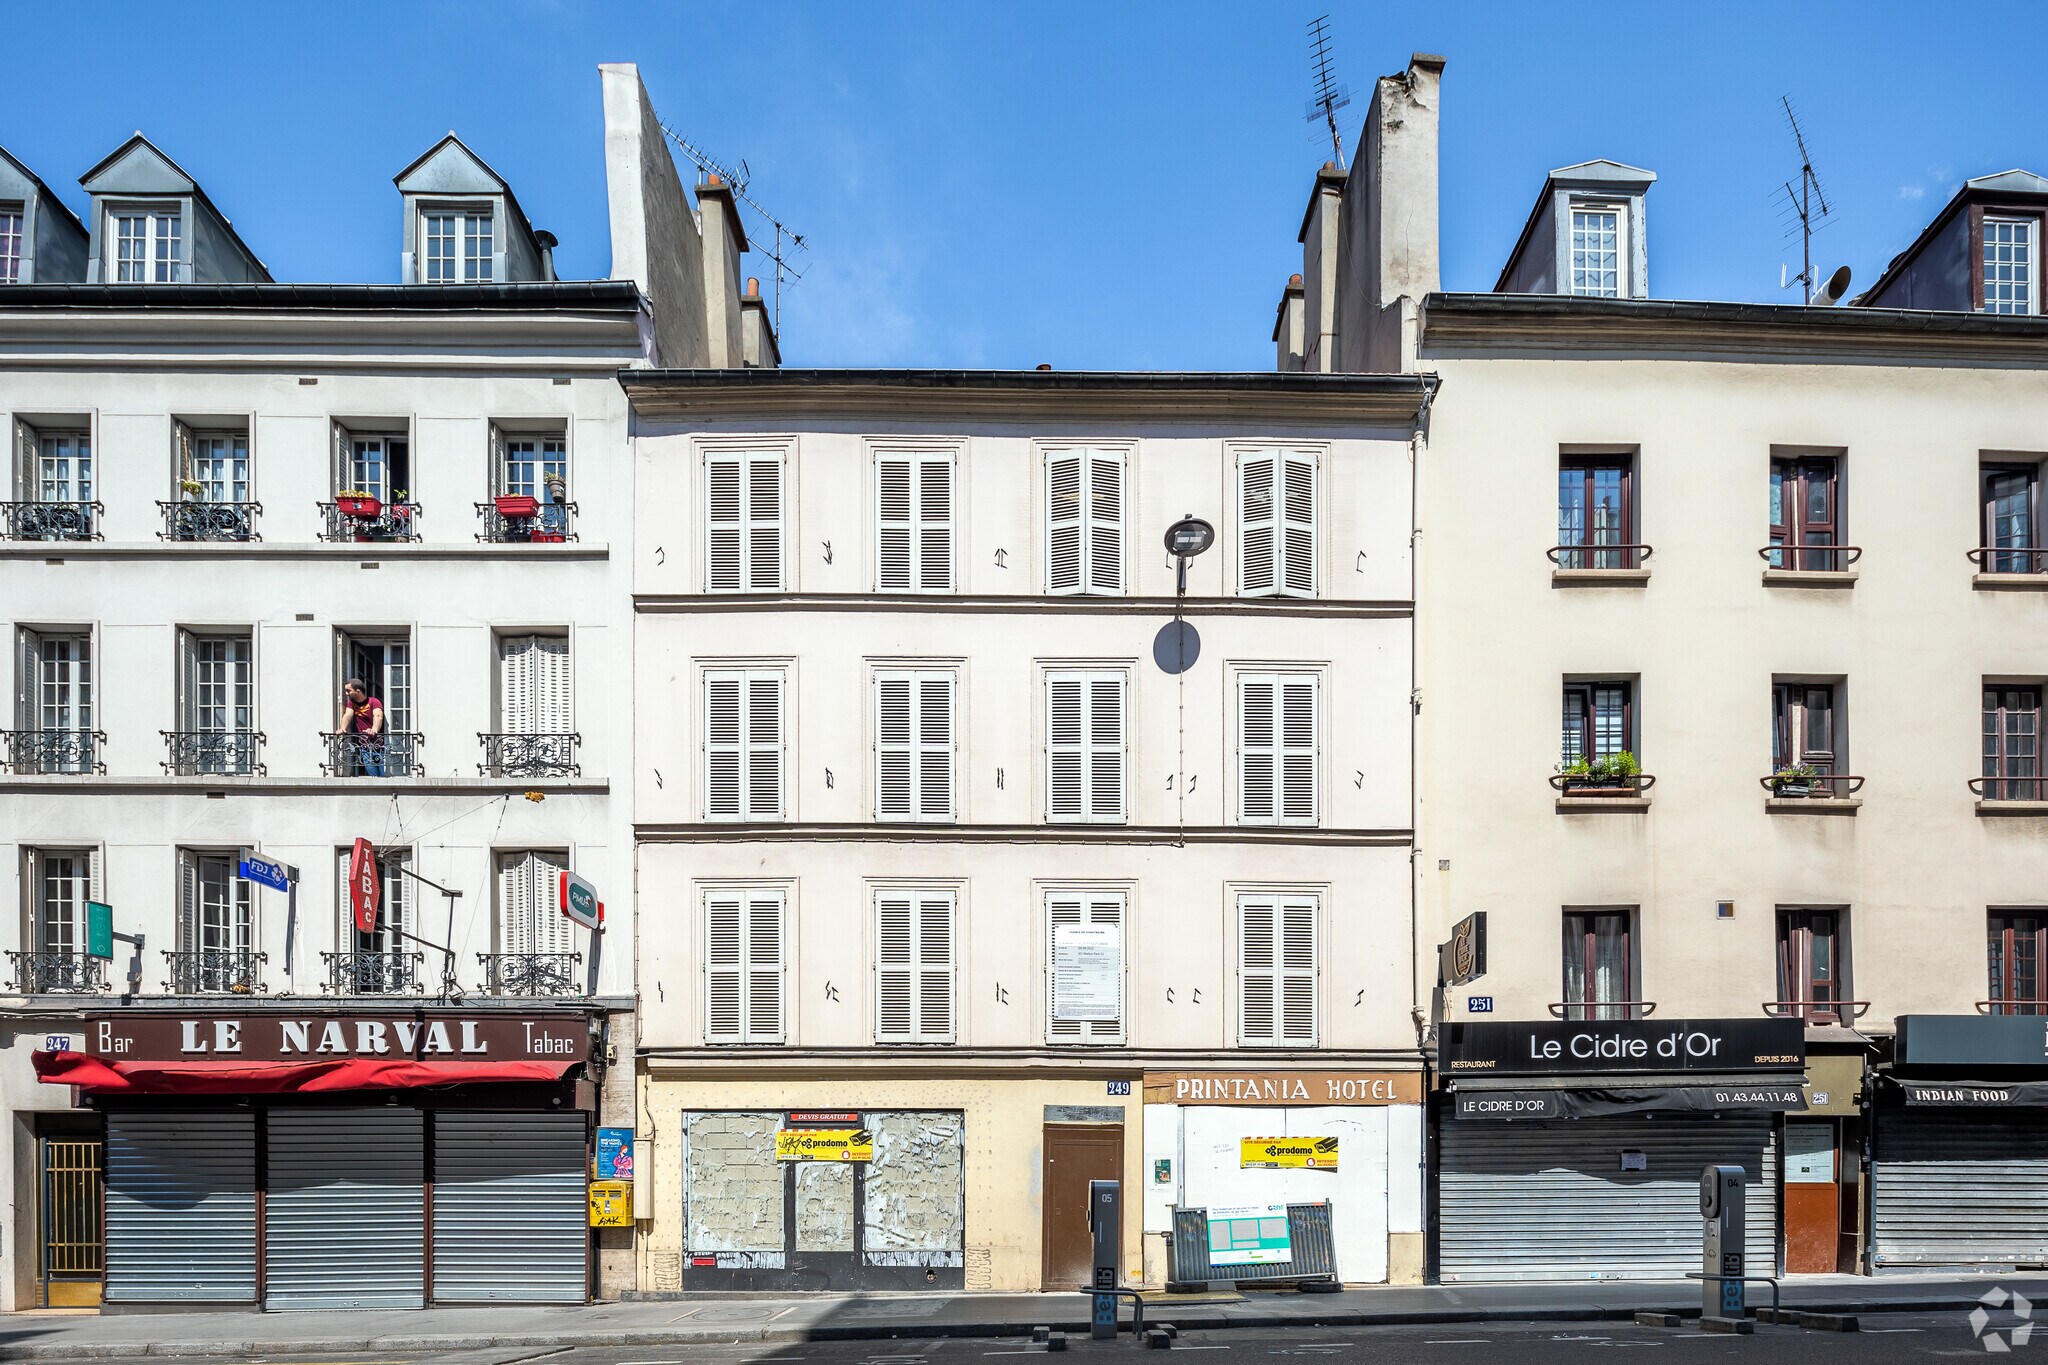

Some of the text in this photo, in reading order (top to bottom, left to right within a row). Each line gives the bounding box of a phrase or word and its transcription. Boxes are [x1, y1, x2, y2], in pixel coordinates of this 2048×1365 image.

[251, 860, 268, 874] FDJ
[362, 848, 373, 923] TABAC
[572, 891, 586, 906] PMU
[1470, 998, 1491, 1011] 251
[47, 1037, 69, 1050] 247
[98, 1021, 134, 1053] Bar
[180, 1020, 488, 1055] LE NARVAL
[522, 1022, 574, 1054] Tabac
[1530, 1032, 1721, 1059] Le Cidre d'Or
[1451, 1060, 1496, 1069] RESTAURANT
[1754, 1055, 1799, 1063] DEPUIS 2016
[1108, 1082, 1130, 1095] 249
[1175, 1078, 1398, 1100] PRINTANIA HOTEL
[1715, 1092, 1798, 1102] 01.43.44.11.48
[1813, 1093, 1827, 1104] 251
[1915, 1090, 2009, 1101] INDIAN FOOD
[1464, 1100, 1544, 1112] LE CIDRE D'OR
[812, 1139, 848, 1148] prodomo
[1277, 1146, 1313, 1155] prodomo
[1727, 1178, 1739, 1188] 04
[1101, 1193, 1112, 1203] 05
